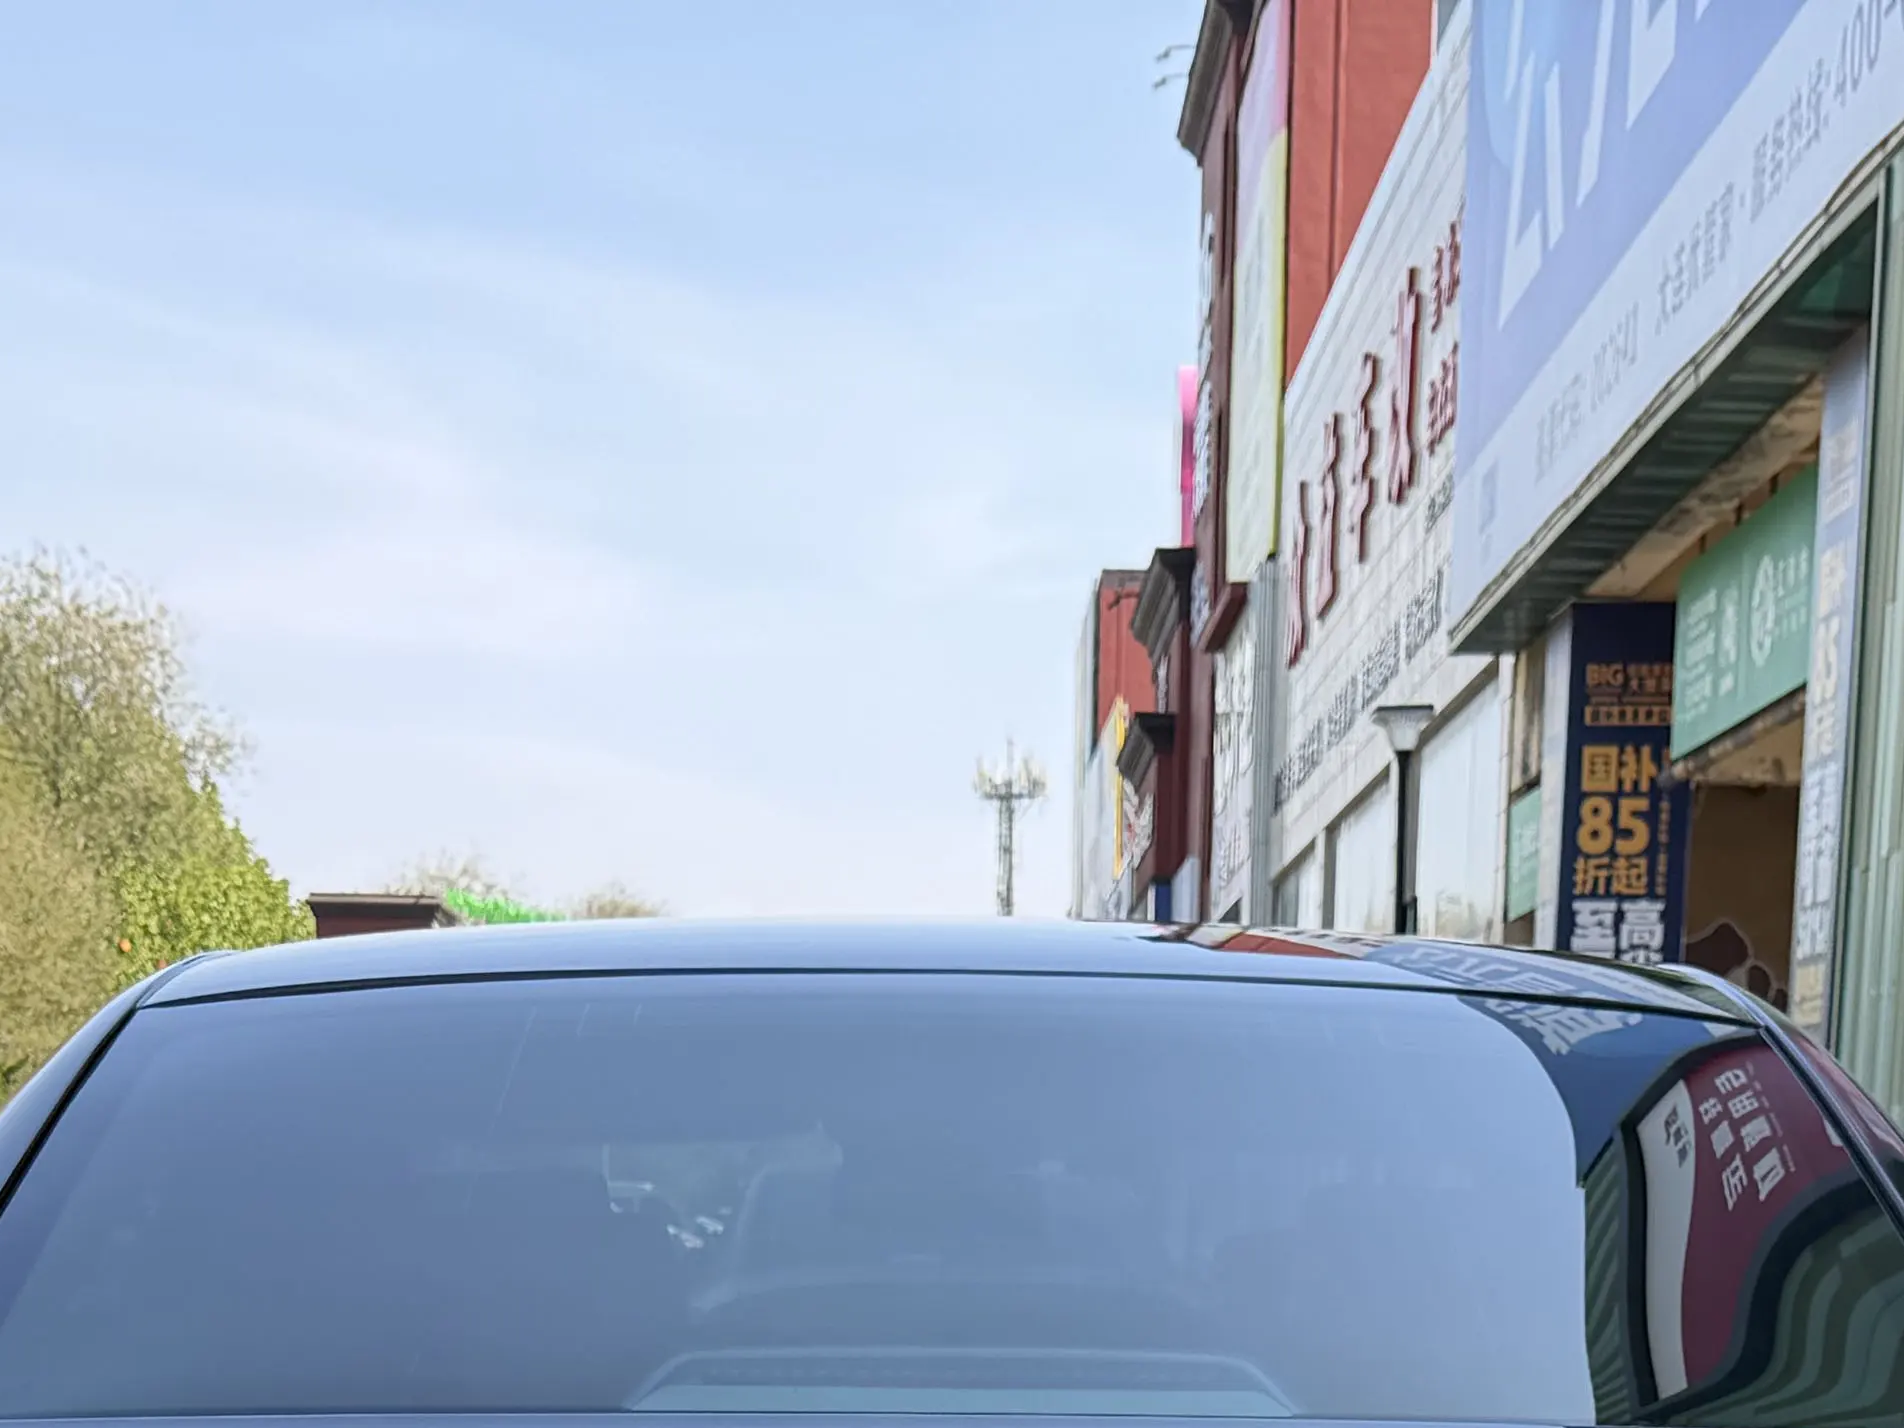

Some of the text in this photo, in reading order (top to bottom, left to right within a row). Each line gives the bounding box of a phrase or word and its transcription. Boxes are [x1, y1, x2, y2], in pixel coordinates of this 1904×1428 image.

[1580, 743, 1660, 793] 国补
[1576, 795, 1651, 857] 85
[1572, 855, 1649, 896] 折起
[1570, 898, 1667, 950] 至高
